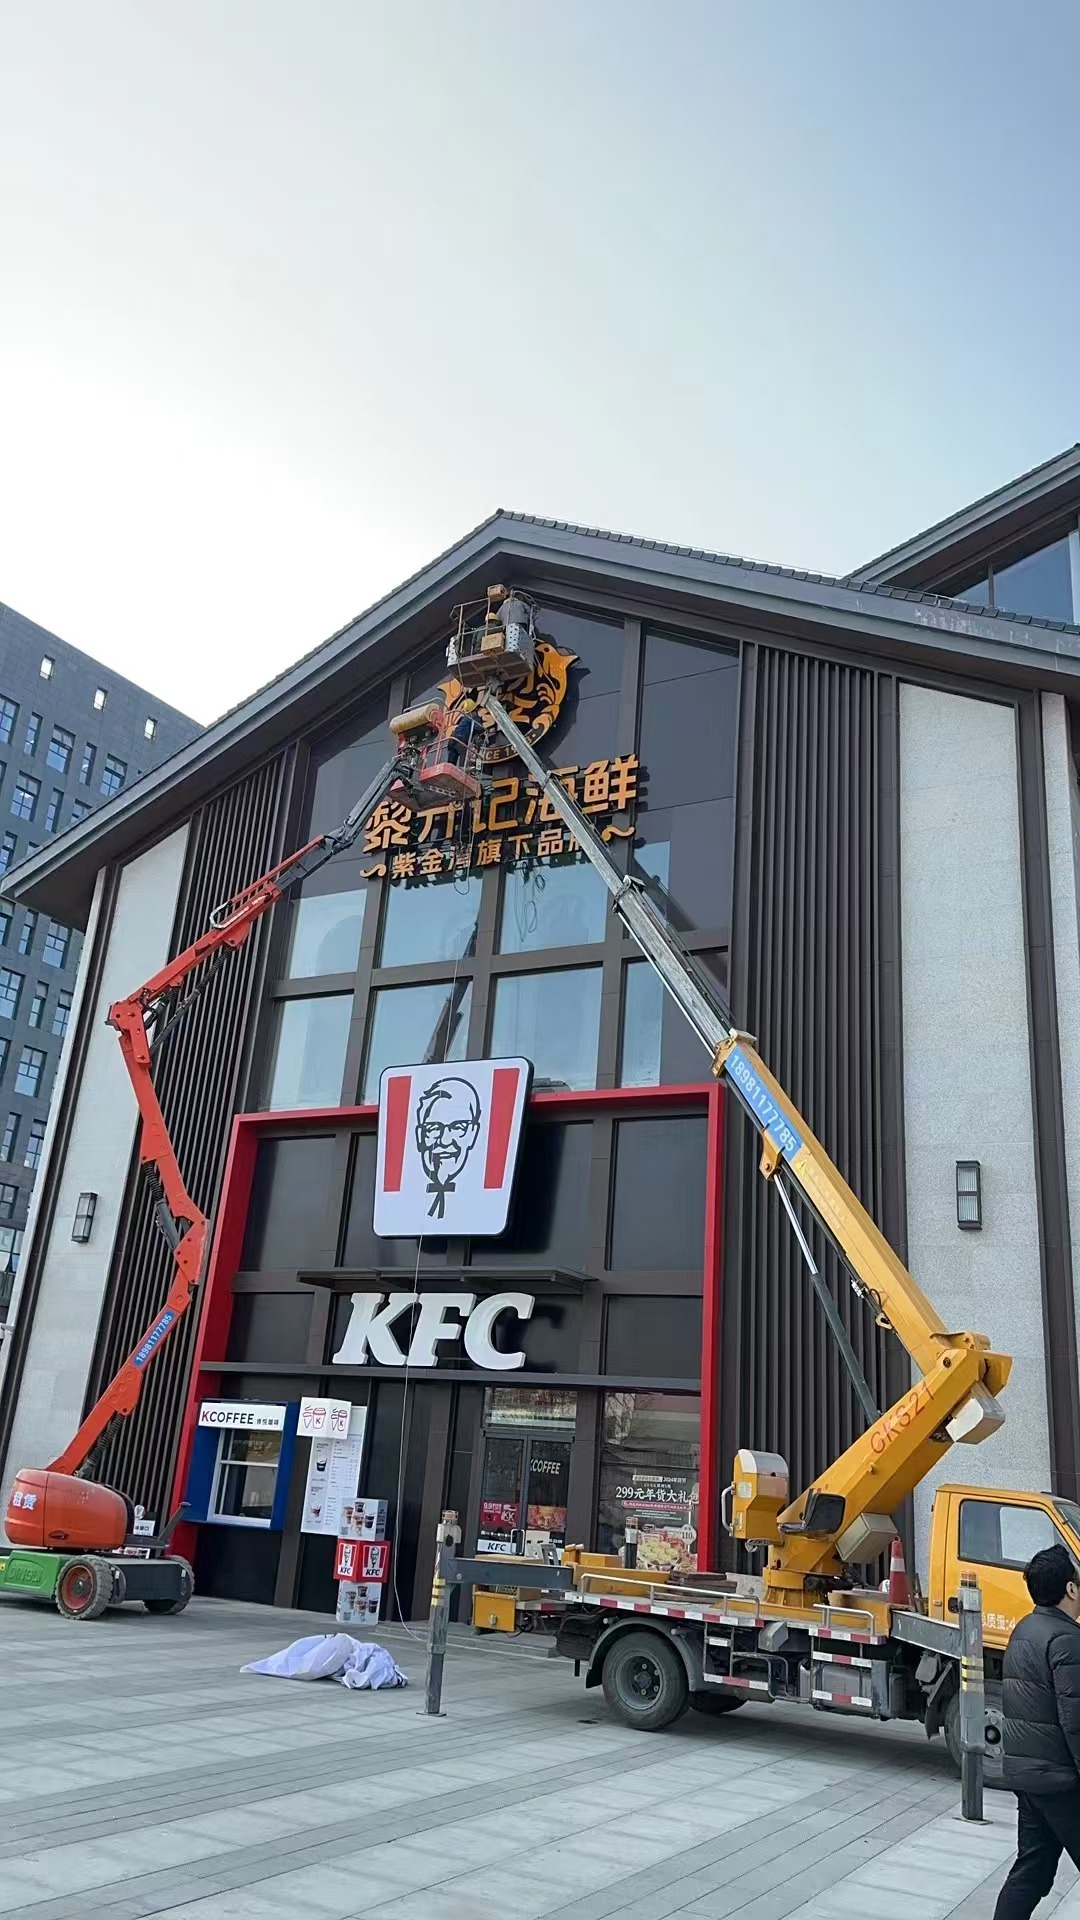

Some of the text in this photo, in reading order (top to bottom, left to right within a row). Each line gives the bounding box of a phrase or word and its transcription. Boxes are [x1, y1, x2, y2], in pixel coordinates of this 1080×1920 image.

[731, 1055, 797, 1151] 18981177785
[136, 1314, 172, 1361] 18981177785
[332, 1292, 535, 1370] KFC
[202, 1411, 254, 1425] KCOFFEE
[616, 1486, 699, 1504] 299元年货大礼包
[487, 1543, 507, 1552] KFC
[340, 1566, 351, 1575] KFC
[365, 1568, 380, 1576] KFC
